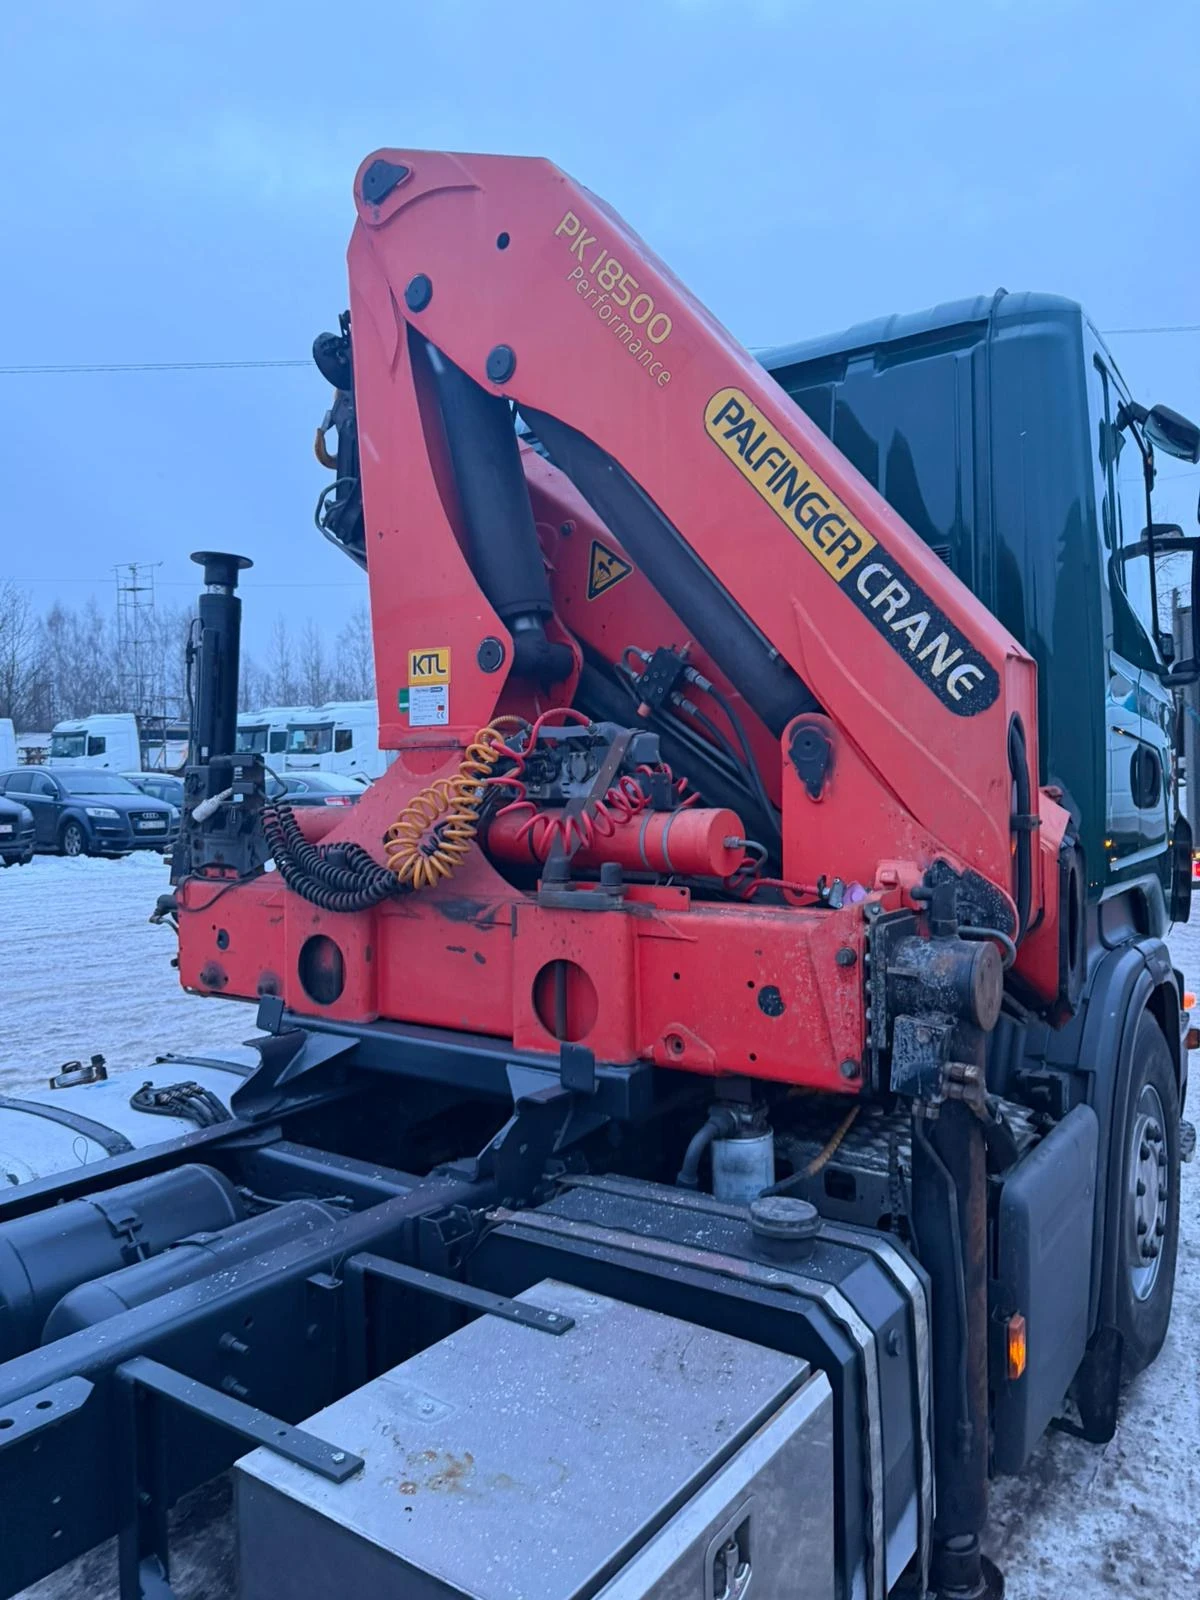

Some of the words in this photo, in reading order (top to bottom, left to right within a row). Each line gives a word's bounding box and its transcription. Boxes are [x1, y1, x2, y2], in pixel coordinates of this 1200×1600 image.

[554, 211, 597, 262] PK
[589, 249, 673, 344] 18500
[567, 266, 672, 387] Performance
[712, 397, 863, 570] PALFINGER
[856, 562, 985, 701] CRANE
[412, 654, 446, 675] KTL
